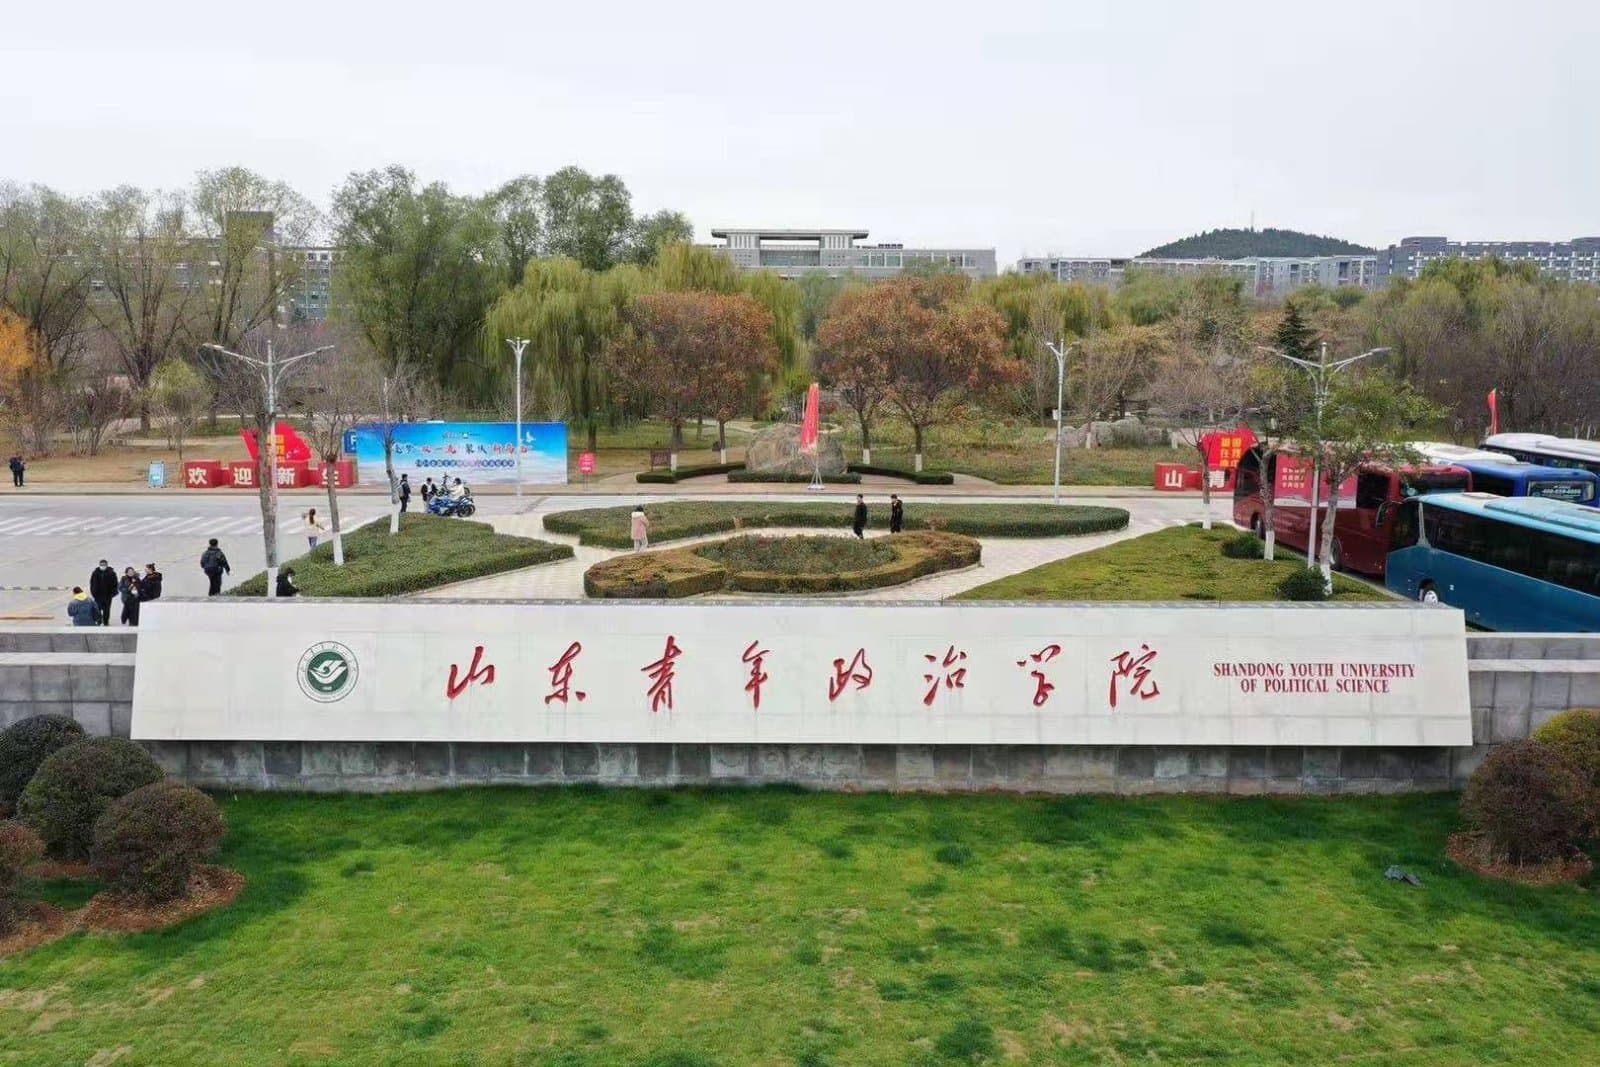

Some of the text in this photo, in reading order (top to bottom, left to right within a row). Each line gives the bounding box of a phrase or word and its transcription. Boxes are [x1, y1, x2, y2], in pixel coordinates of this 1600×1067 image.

[447, 636, 1159, 712] 山东青年政治学院
[1214, 663, 1415, 678] SHANDONG YOUTH UNIVERSITY
[1240, 679, 1390, 693] OF POLITICAL SCIENCE
